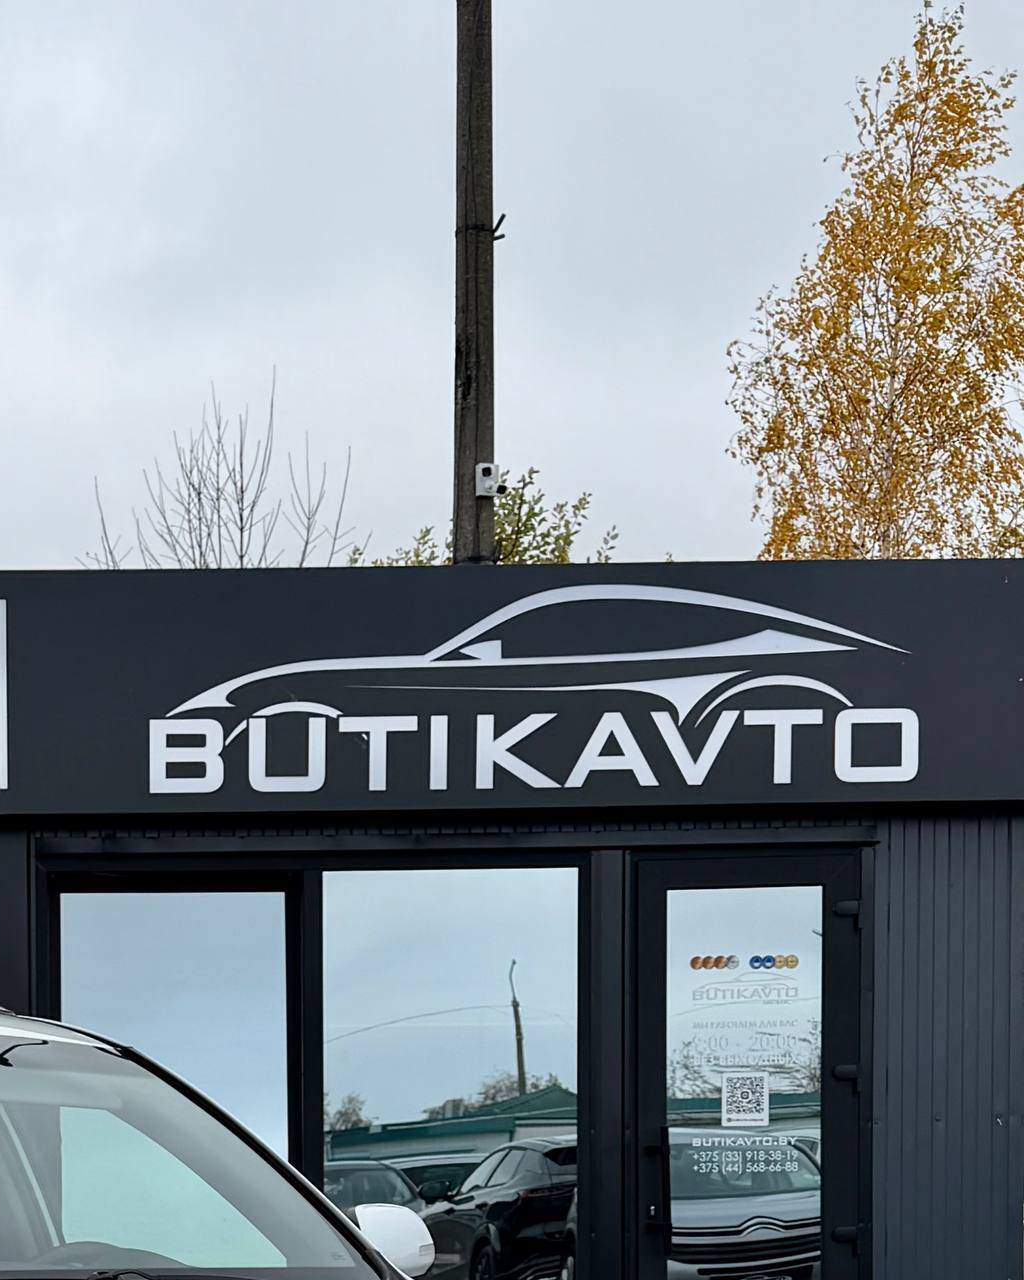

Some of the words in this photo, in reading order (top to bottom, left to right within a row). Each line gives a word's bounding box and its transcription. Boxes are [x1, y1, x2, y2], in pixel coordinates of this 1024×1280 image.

[148, 706, 920, 794] BUTIKAVTO
[692, 986, 799, 1001] BUTIKAVTO
[692, 1136, 798, 1147] BUTIKAVTO.BY
[692, 1151, 720, 1162] +375
[722, 1151, 743, 1163] (33)
[745, 1150, 798, 1161] 918-38-19
[693, 1162, 720, 1173] +375
[722, 1162, 743, 1175] (44)
[745, 1161, 799, 1172] 568-66-88
